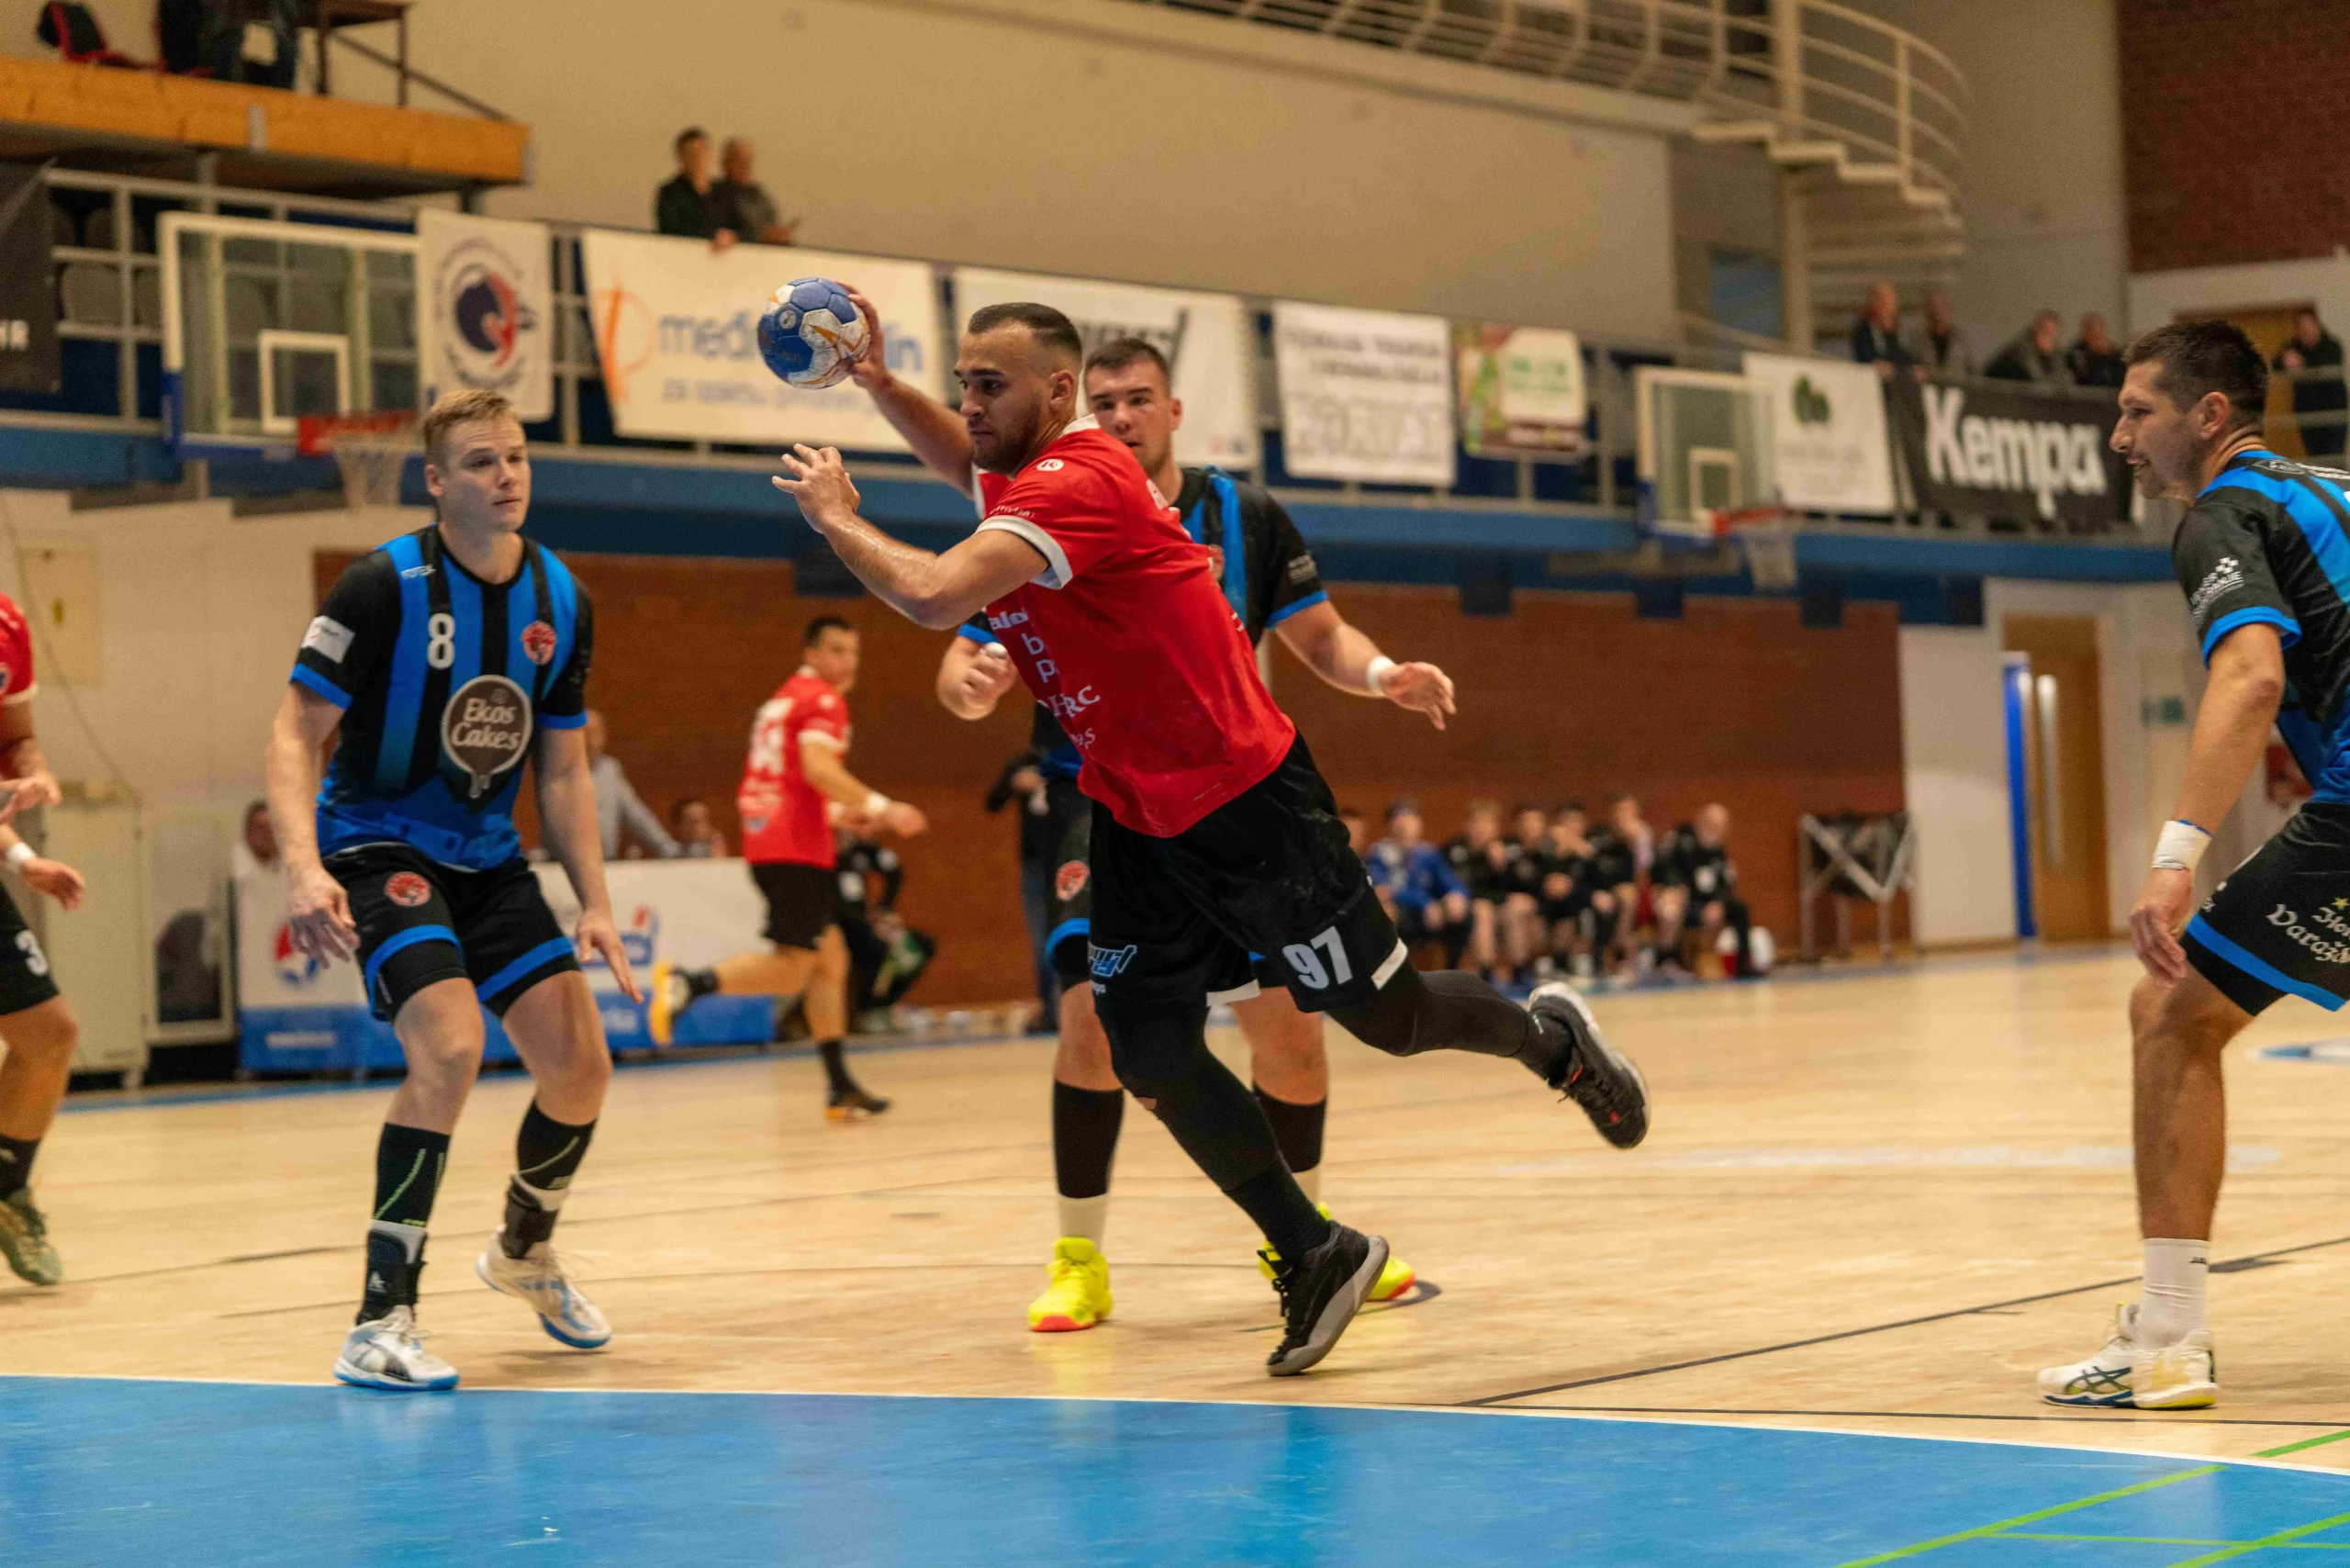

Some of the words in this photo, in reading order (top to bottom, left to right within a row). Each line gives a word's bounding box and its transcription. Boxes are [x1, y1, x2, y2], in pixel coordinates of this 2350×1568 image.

[1922, 385, 2107, 521] Kempa
[427, 612, 456, 670] 8
[1037, 685, 1102, 718] HRC
[451, 721, 521, 750] Cakes
[14, 929, 50, 977] 3
[1281, 925, 1354, 991] 97
